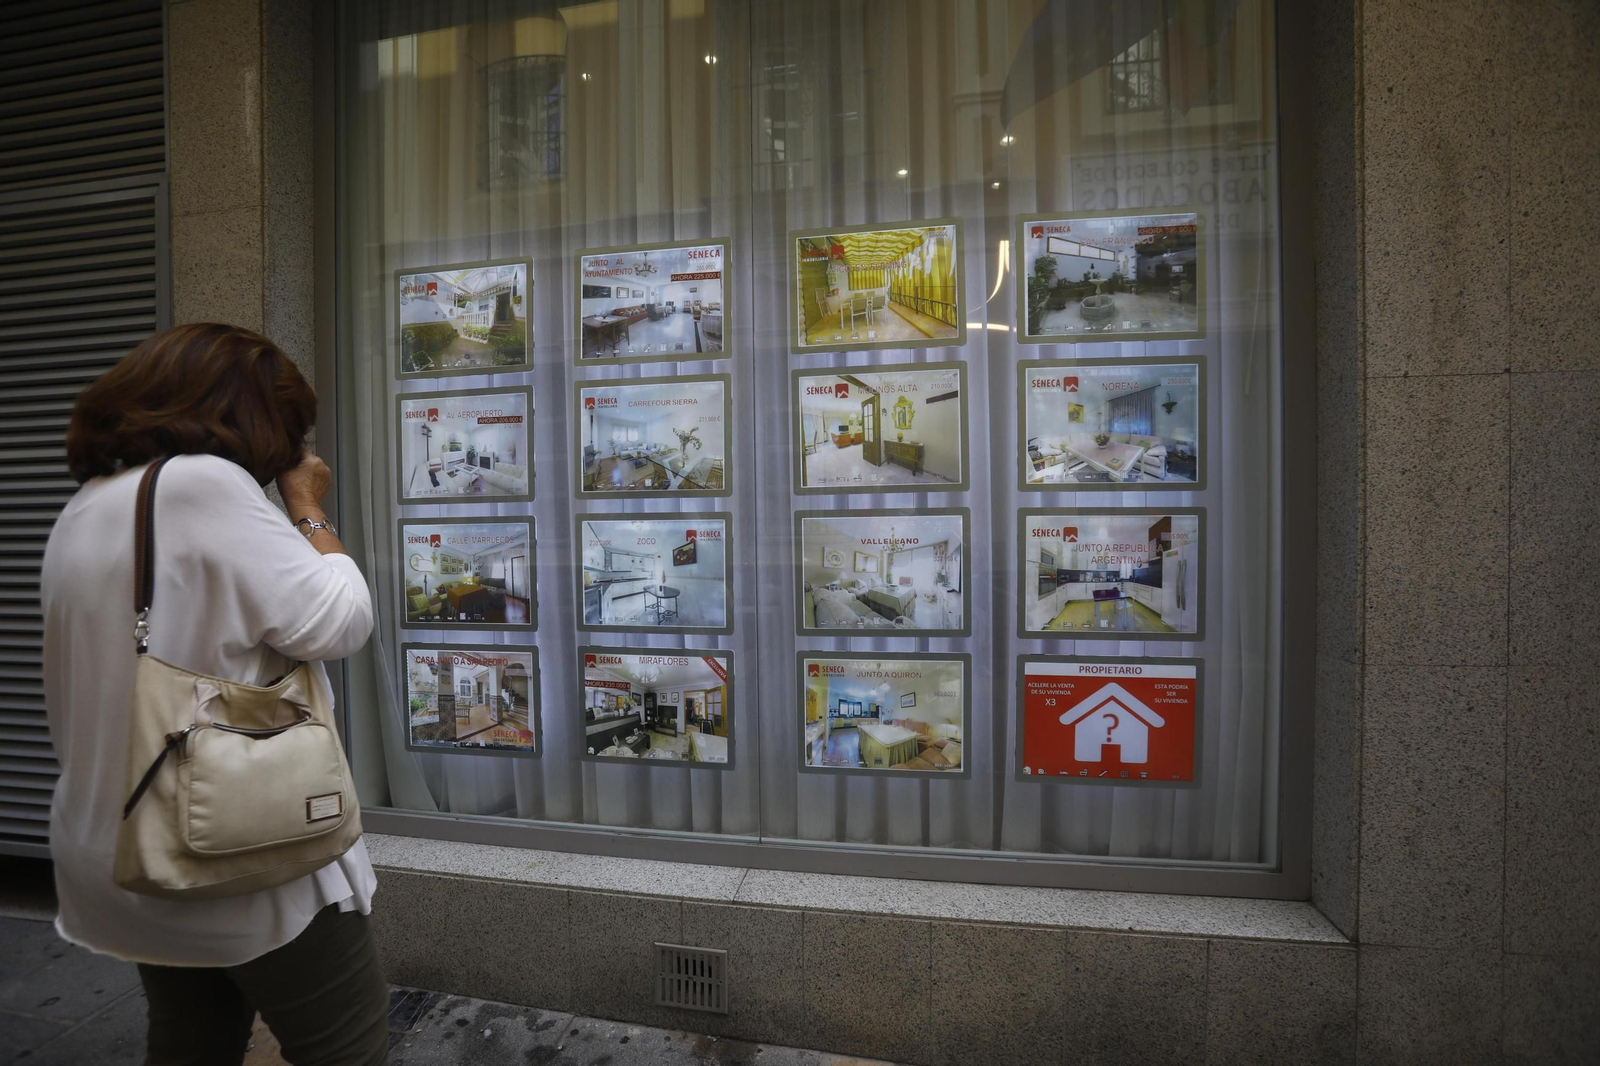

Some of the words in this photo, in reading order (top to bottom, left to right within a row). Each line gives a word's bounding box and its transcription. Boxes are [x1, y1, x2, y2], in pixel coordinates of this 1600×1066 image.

[587, 259, 609, 268] JUNTO
[615, 258, 624, 266] AL
[584, 267, 633, 278] AYUNTAMIENTO
[898, 384, 918, 393] ALTA
[628, 399, 671, 408] CARREFOUR
[672, 398, 699, 406] SIERRA
[457, 409, 503, 419] AEROPUERTO
[447, 536, 469, 545] CALLE
[860, 537, 919, 545] VALLELLANO
[1073, 543, 1102, 553] JUNTO
[1105, 543, 1111, 552] A
[1091, 555, 1143, 565] ARGENTINA
[415, 655, 435, 665] CASA
[638, 656, 689, 666] MIRAFLORES
[707, 658, 727, 680] EXCLUSIVA
[1078, 665, 1143, 675] PROPIETARIO
[1045, 698, 1056, 706] X3
